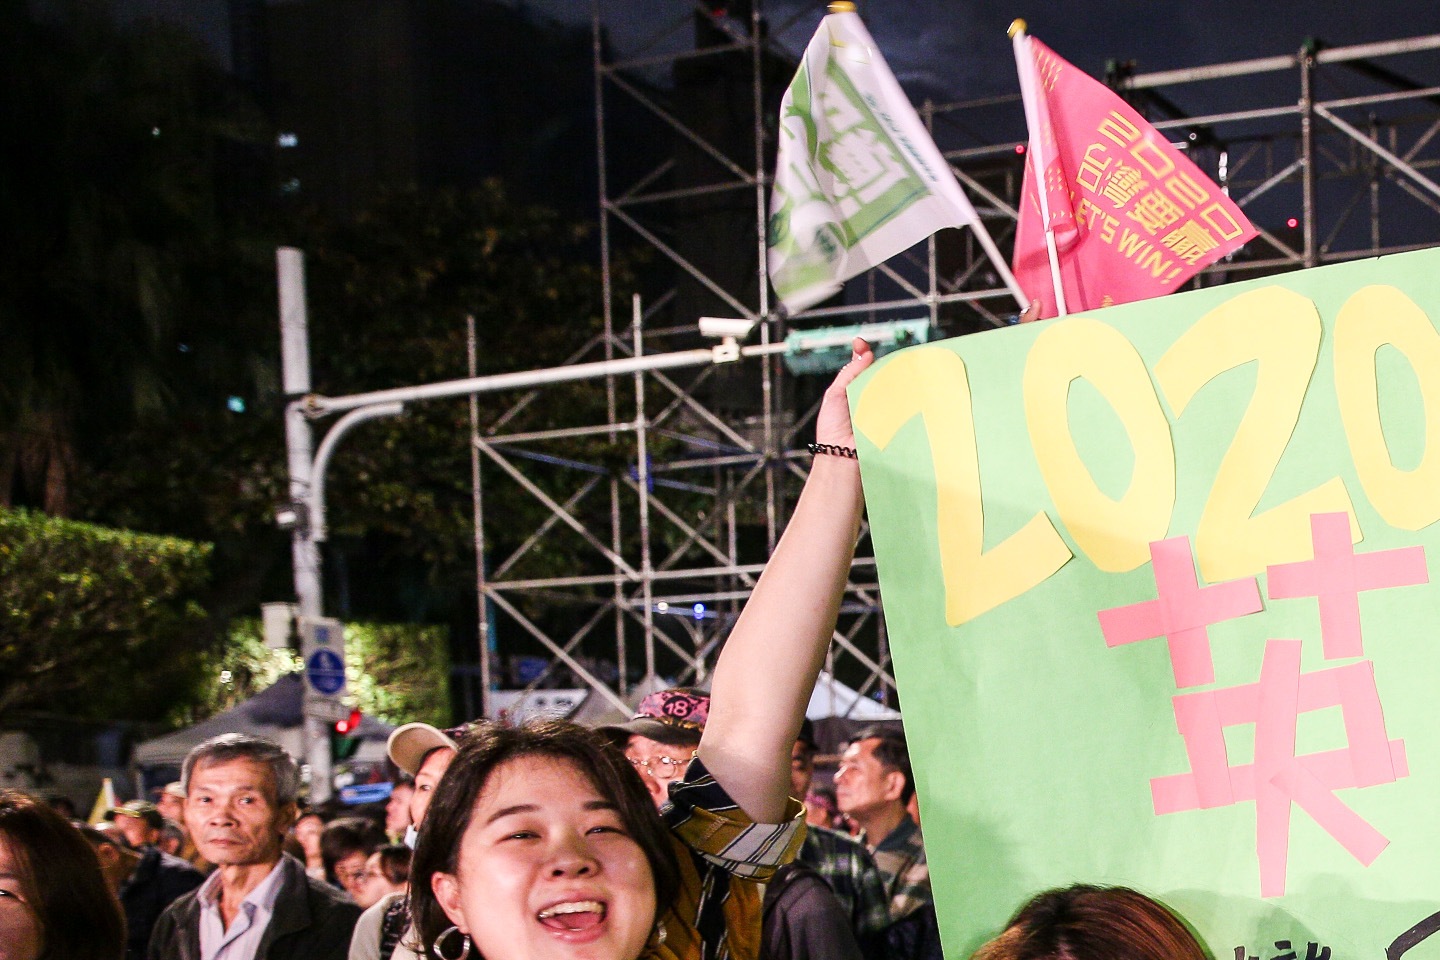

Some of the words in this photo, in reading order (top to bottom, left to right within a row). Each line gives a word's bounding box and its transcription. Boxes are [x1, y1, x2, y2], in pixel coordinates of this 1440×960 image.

[1075, 142, 1221, 266] 台灣要贏
[1097, 109, 1244, 242] 2020
[1071, 191, 1121, 245] ET'S
[1117, 227, 1183, 285] WIN!
[665, 701, 690, 718] 18
